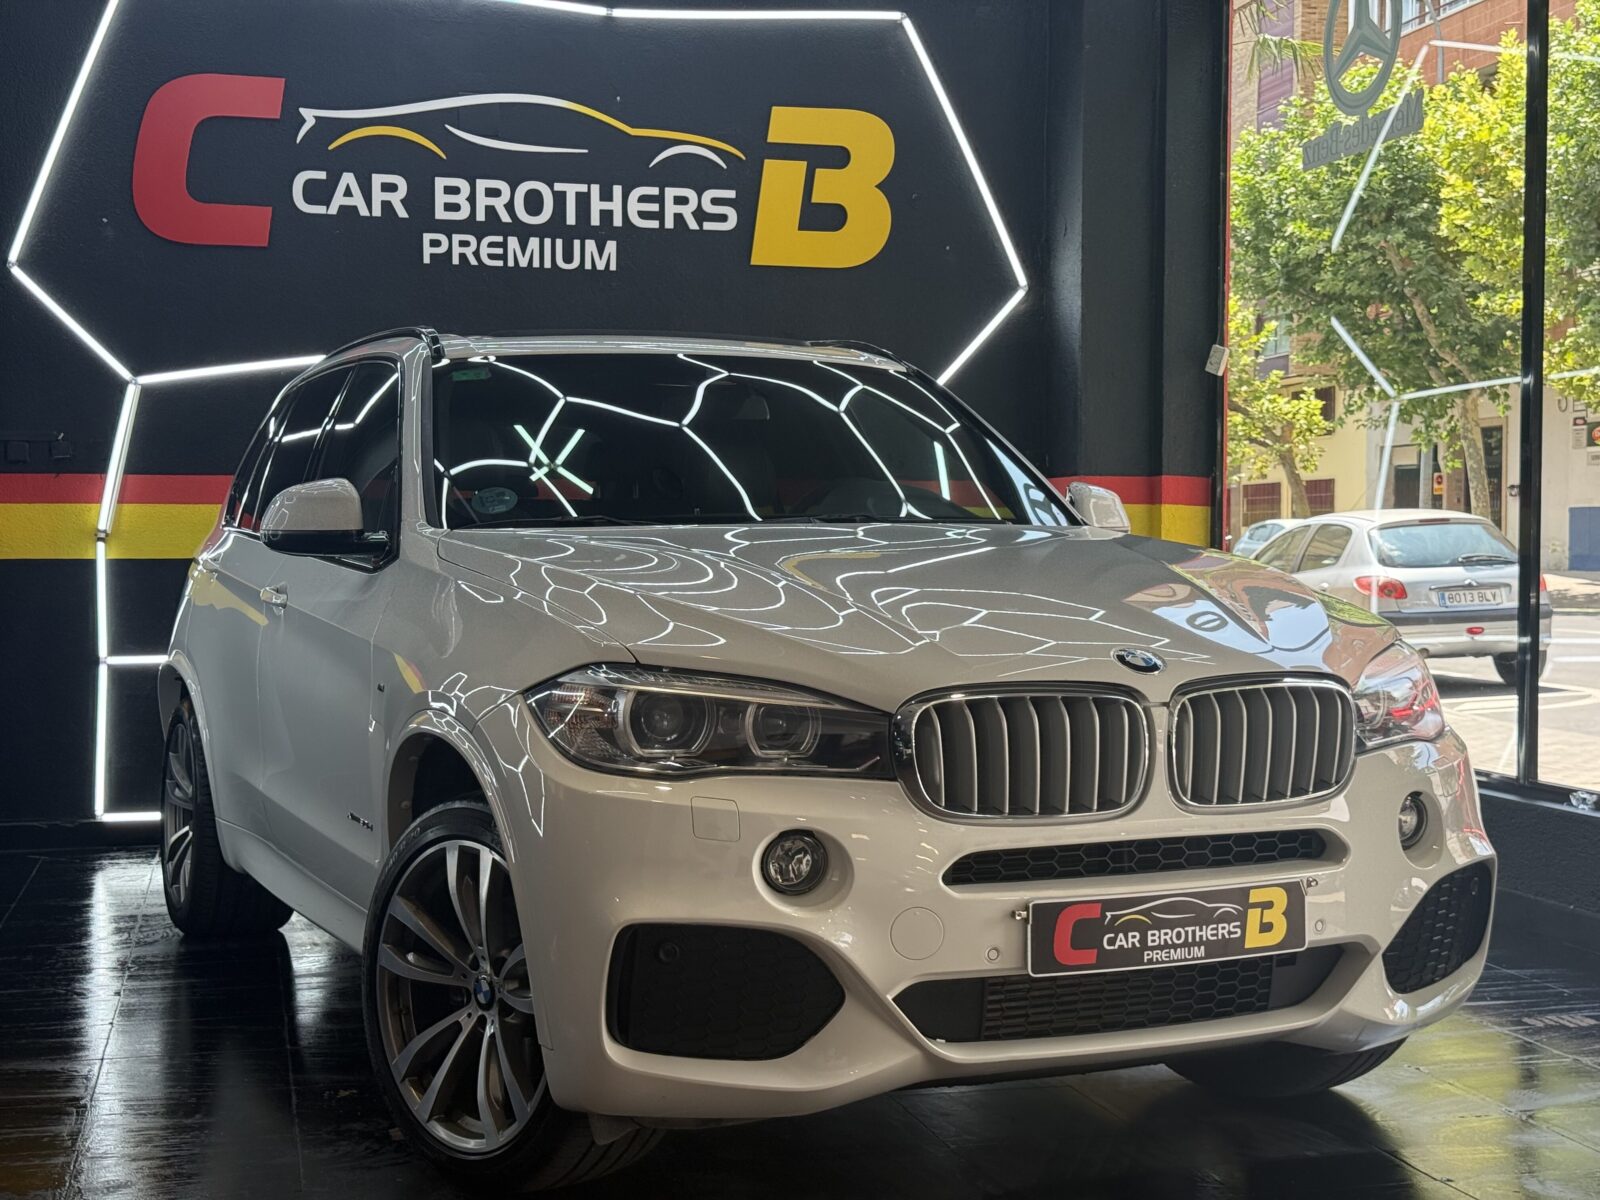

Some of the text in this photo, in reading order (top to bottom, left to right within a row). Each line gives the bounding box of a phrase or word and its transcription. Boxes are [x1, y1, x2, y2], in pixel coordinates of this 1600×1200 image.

[132, 73, 285, 247] C
[751, 105, 896, 268] B
[292, 170, 738, 231] CAR BROTHERS
[422, 232, 617, 271] PREMIUM
[1448, 592, 1475, 604] 8013
[1053, 902, 1102, 966] C
[1102, 921, 1242, 950] CAR BROTHERS
[1245, 886, 1288, 949] B
[1143, 946, 1205, 963] PREMIUM
